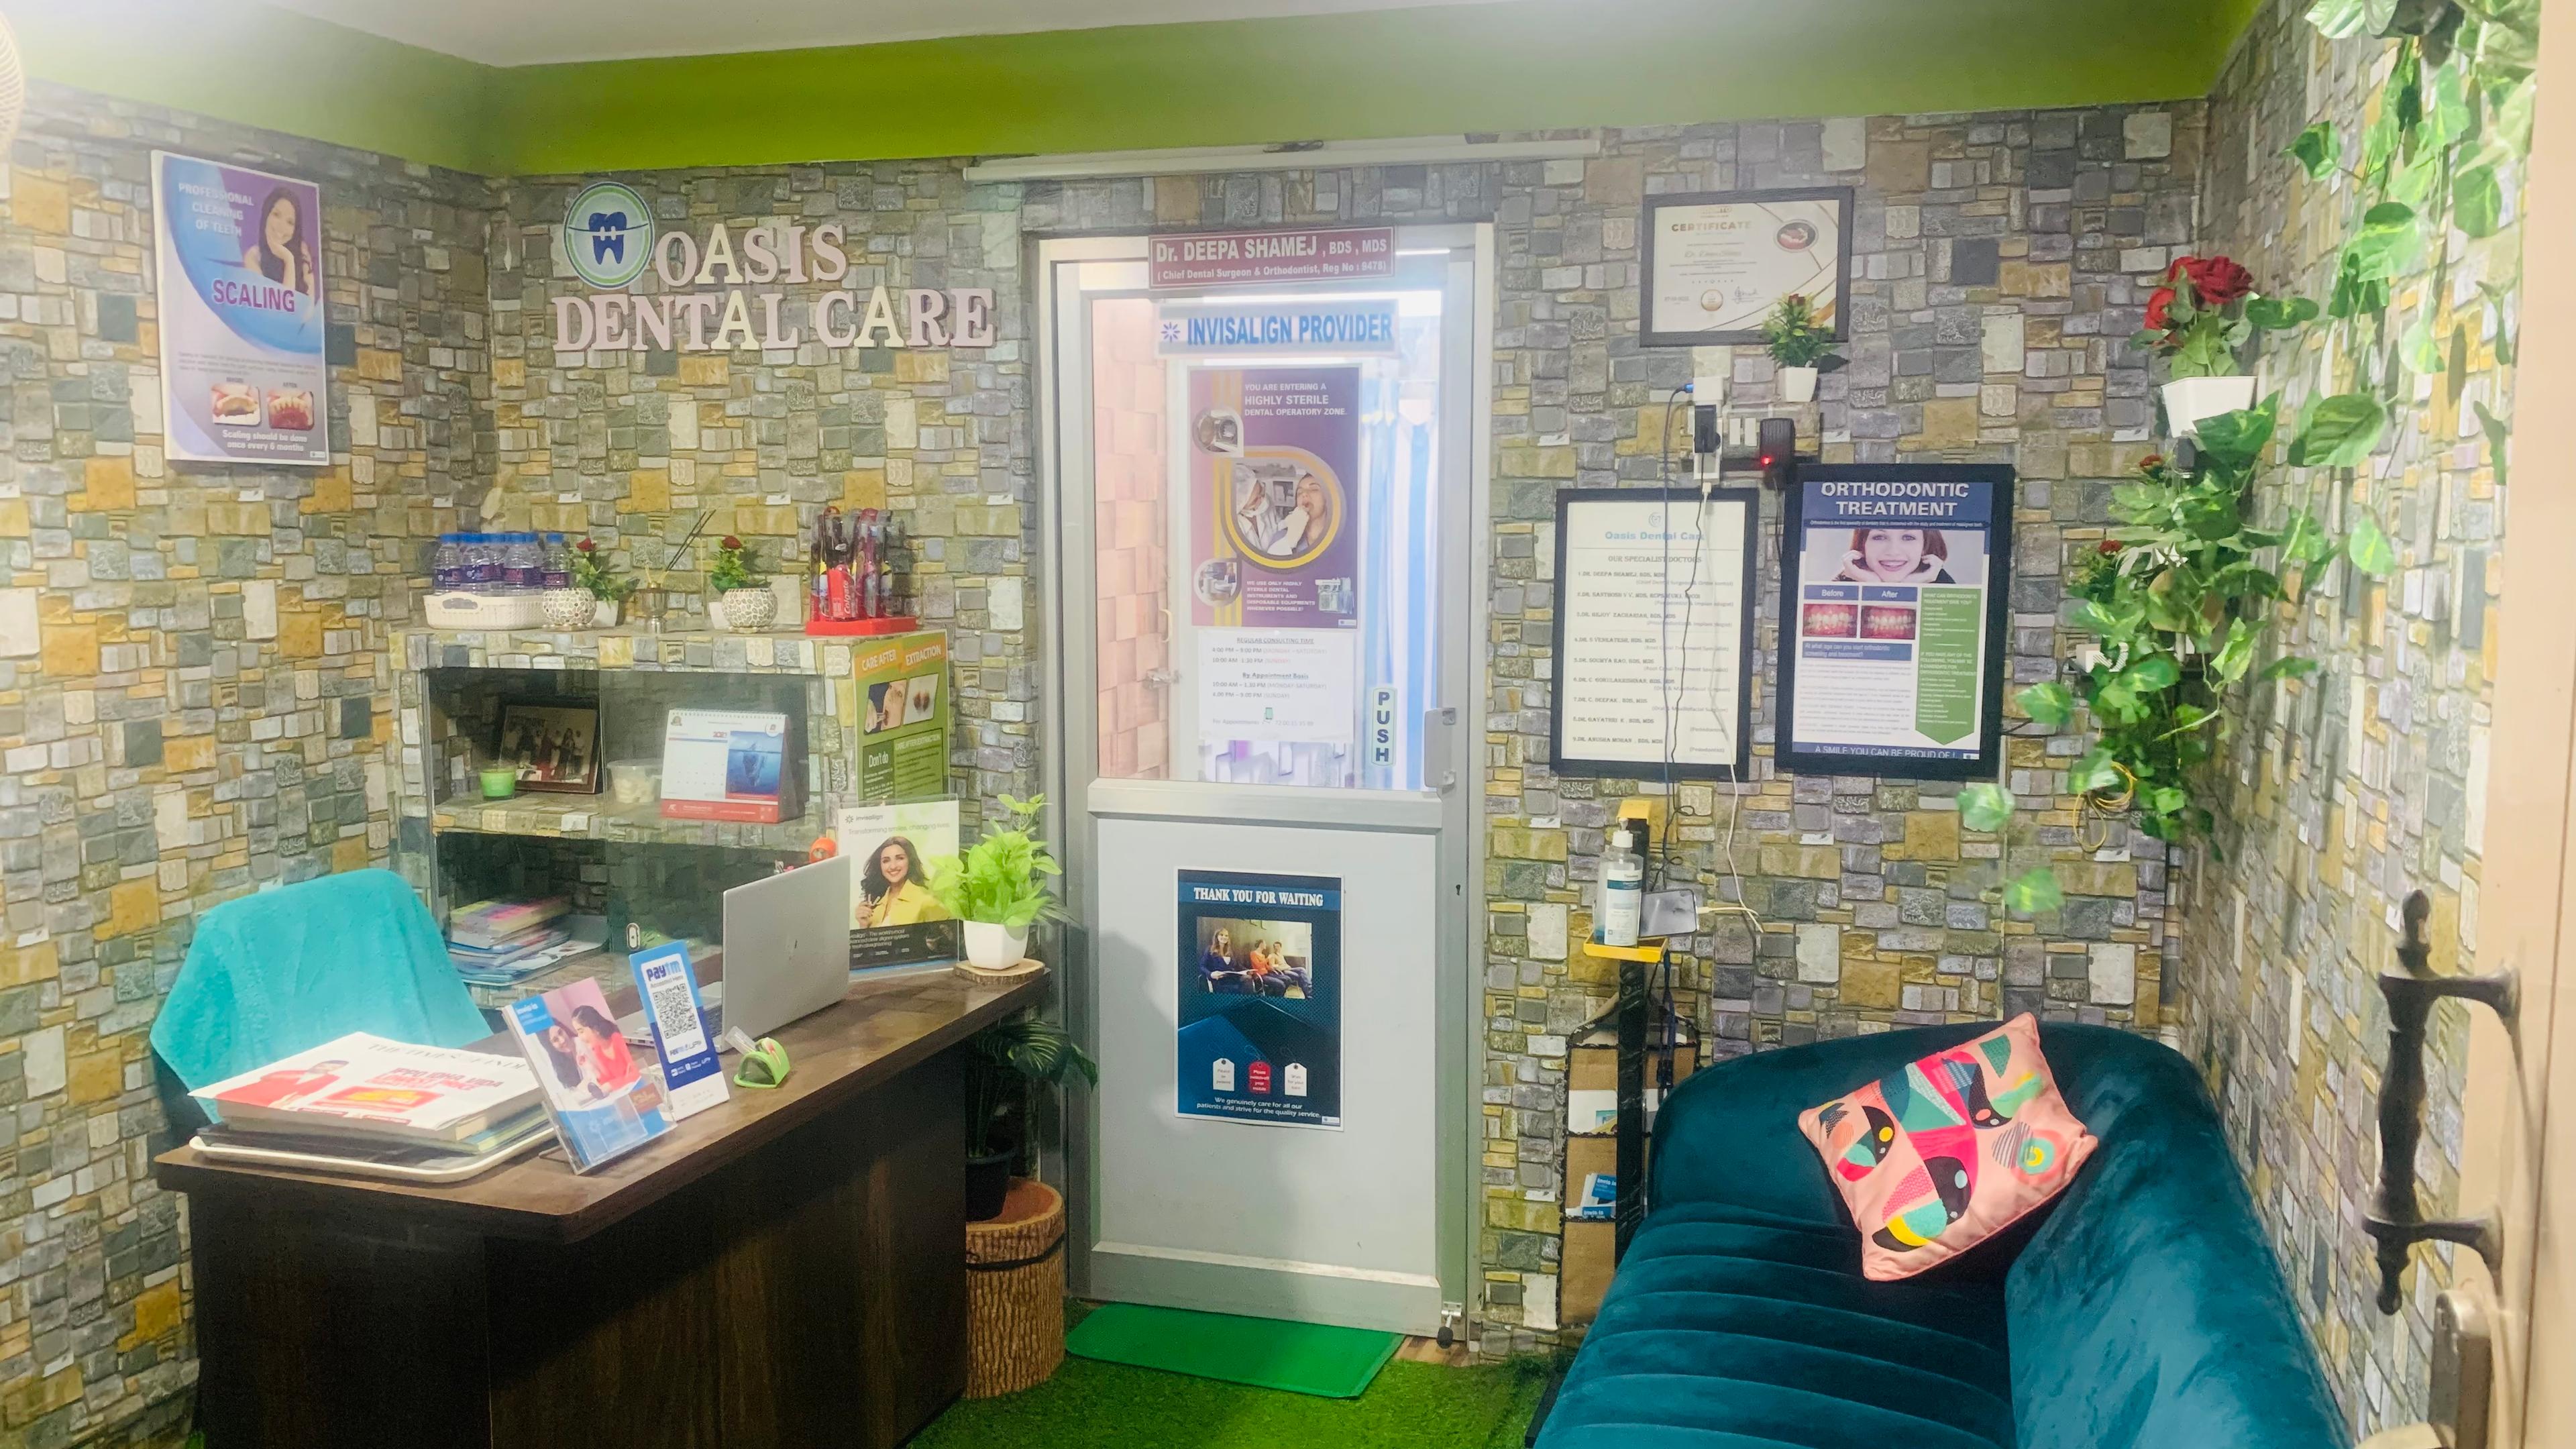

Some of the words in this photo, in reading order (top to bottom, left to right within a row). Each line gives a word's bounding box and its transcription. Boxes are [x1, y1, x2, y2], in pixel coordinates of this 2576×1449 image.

[178, 182, 254, 206] PROFESSIONAL
[193, 203, 244, 221] CLEANING
[196, 221, 209, 230] OF
[213, 223, 242, 237] TEETH
[1672, 221, 1752, 231] CERTIFICATE
[655, 223, 846, 287] OASIS
[1157, 243, 1178, 262] Dr.
[1184, 239, 1240, 261] DEEPA
[1362, 239, 1387, 252] MDS
[1187, 268, 1214, 278] Dental
[1217, 268, 1251, 280] Surgeon
[1254, 267, 1260, 276] &
[1264, 264, 1320, 278] Orthodontist,
[1323, 264, 1339, 276] Reg
[213, 279, 295, 313] SCALING
[551, 290, 799, 351] DENTAL
[816, 285, 995, 349] CARE
[1187, 315, 1292, 345] INVISALIGN
[1299, 313, 1392, 343] PROVIDER
[1244, 396, 1282, 405] HIGHLY
[1286, 395, 1329, 405] STERILE
[222, 429, 251, 441] Scaling
[253, 432, 277, 441] should
[290, 434, 307, 442] done
[248, 443, 268, 451] every
[276, 443, 304, 451] months
[1821, 482, 1970, 497] ORTHODONTIC
[1836, 501, 1957, 516] TREATMENT
[1605, 531, 1636, 539] Oasis
[862, 654, 878, 671] CARE
[878, 649, 896, 665] AFTER
[906, 645, 941, 666] EXTRACTION
[1375, 692, 1391, 762] PUSH
[916, 735, 941, 747] EXTRACTION
[869, 752, 881, 767] Don't
[882, 752, 888, 763] do
[1849, 747, 1868, 755] YOU
[1871, 748, 1889, 756] CAN
[1904, 749, 1936, 758] PROUD
[849, 826, 888, 835] Transforming
[909, 822, 936, 832] changing
[1193, 887, 1230, 902] THANK
[1232, 890, 1253, 902] YOU
[1256, 891, 1276, 904] FOR
[1279, 892, 1324, 906] WAITING
[650, 979, 671, 989] Accepted
[672, 974, 684, 983] Here
[369, 1044, 399, 1053] THE
[466, 1078, 504, 1087] VIDA
[1227, 1098, 1256, 1107] genuinely
[1275, 1110, 1297, 1118] quality
